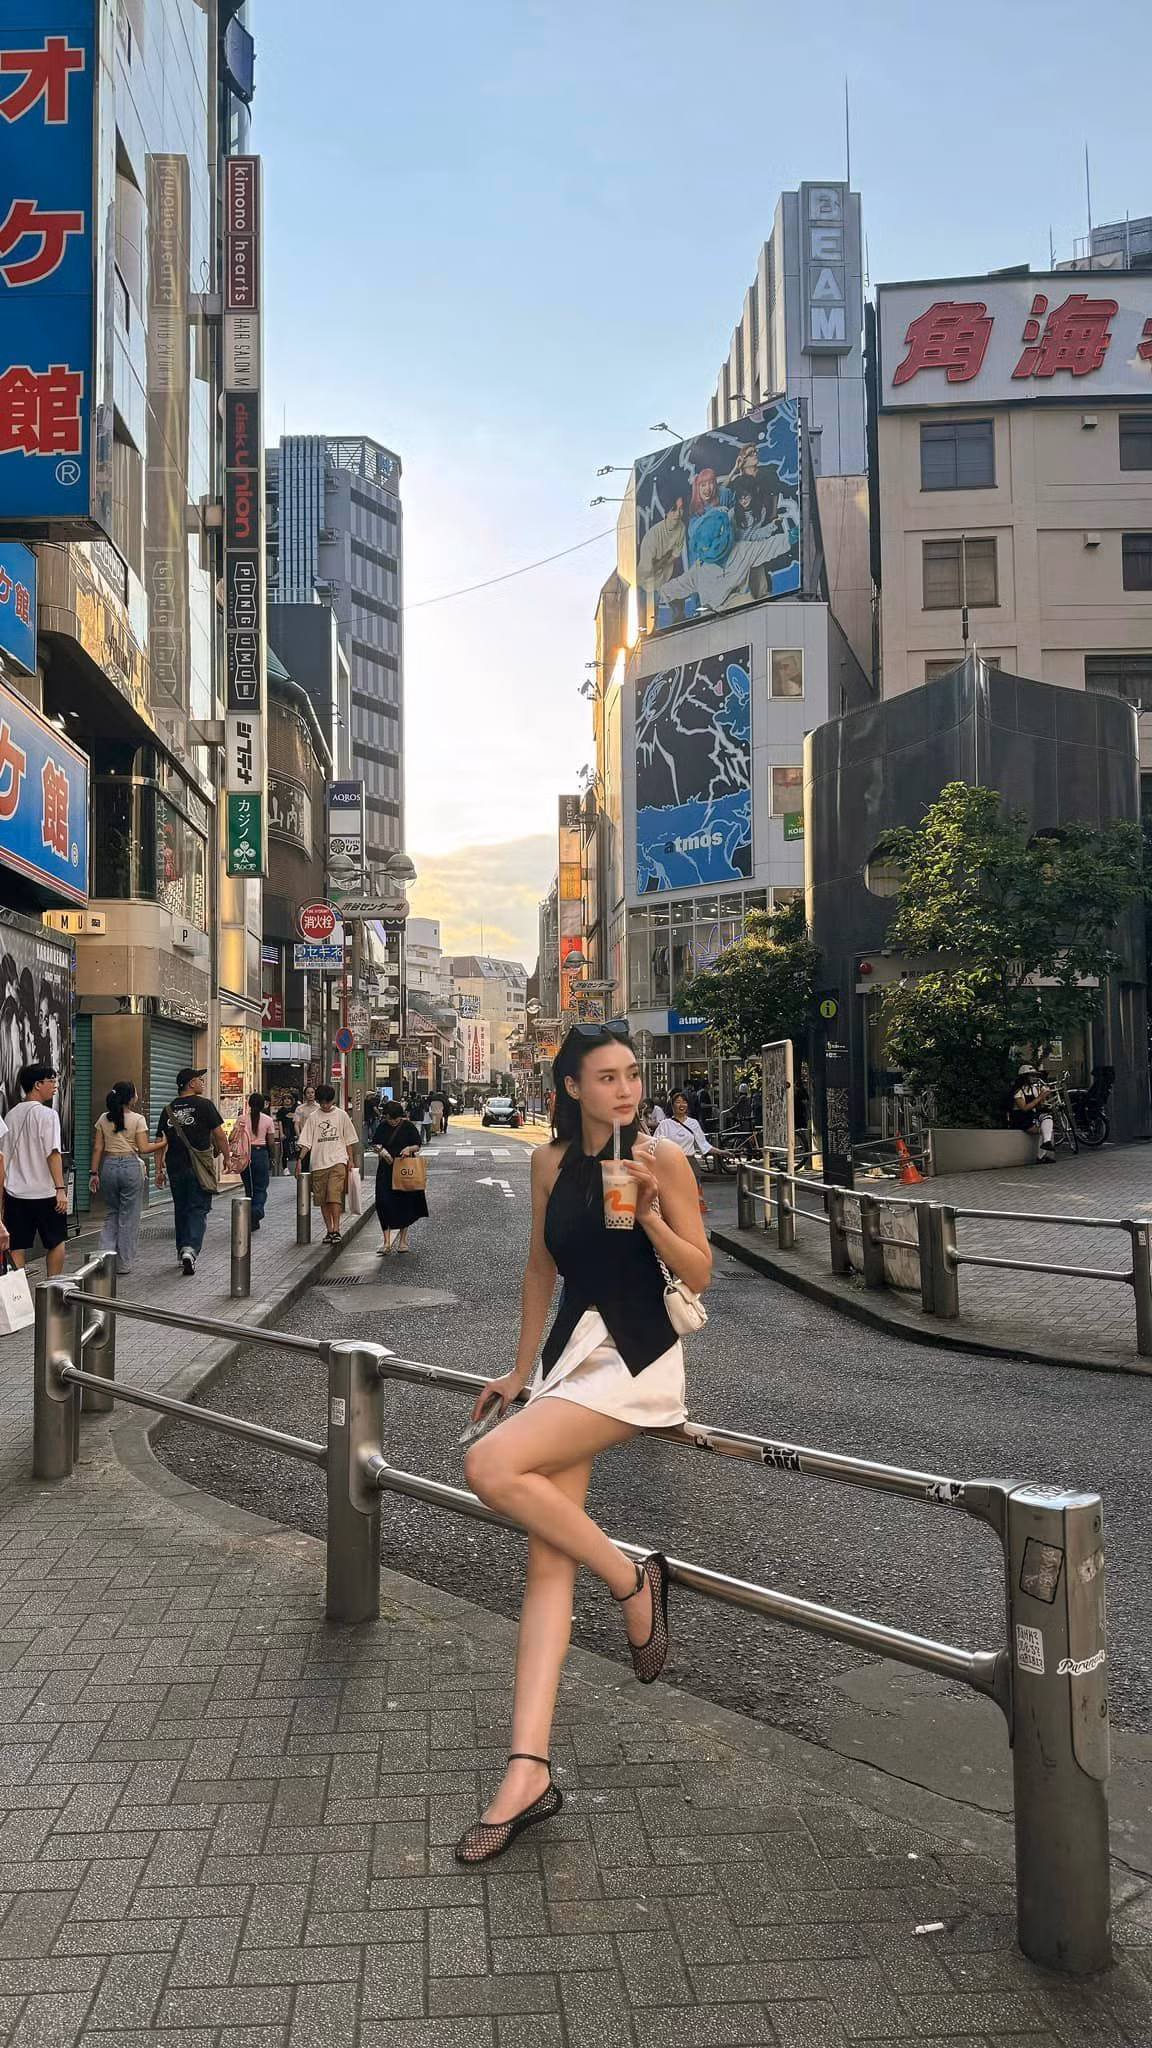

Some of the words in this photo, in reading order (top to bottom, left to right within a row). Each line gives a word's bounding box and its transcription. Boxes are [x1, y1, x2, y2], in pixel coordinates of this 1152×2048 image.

[234, 166, 248, 230] kimono
[234, 241, 248, 301] hearts
[811, 188, 845, 340] BEAM
[233, 317, 250, 341] HAIR
[893, 293, 1152, 386] 角海
[233, 344, 250, 373] SALON
[238, 799, 251, 839] カジノ
[664, 832, 724, 855] atmos
[304, 915, 333, 929] 消火栓
[400, 1168, 414, 1176] GU
